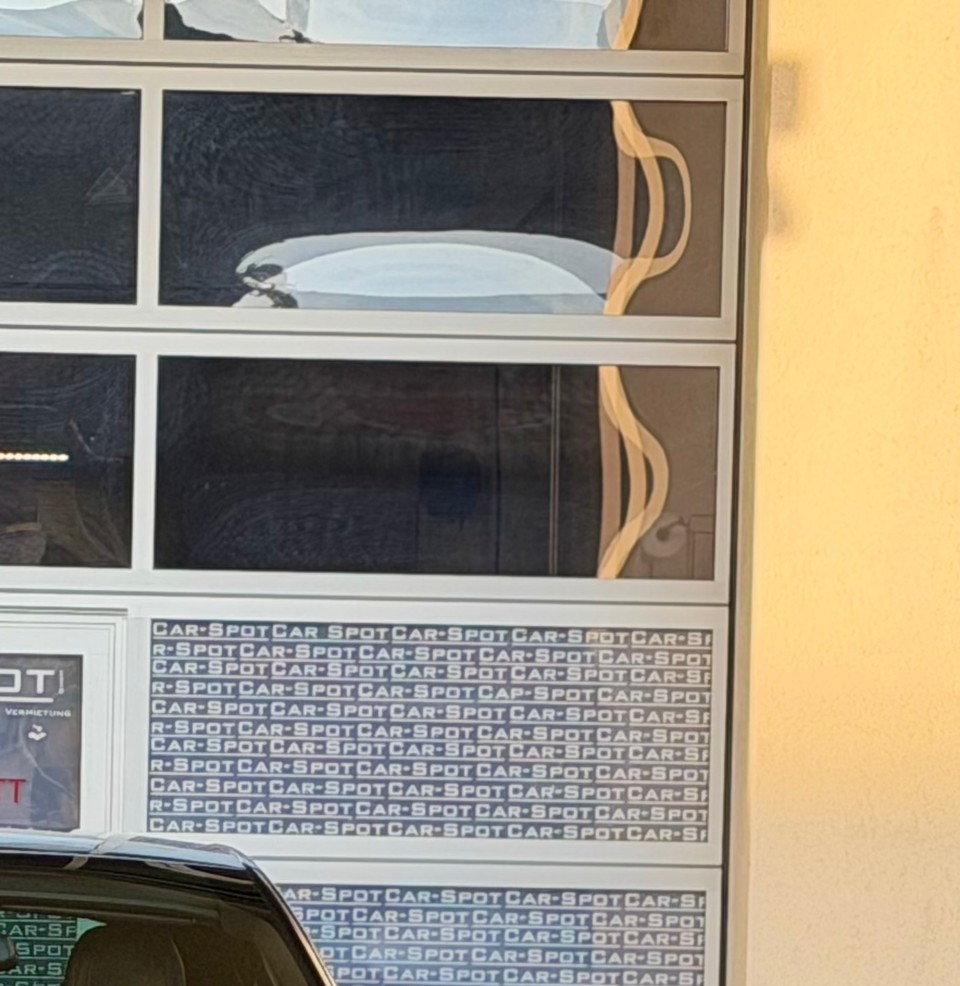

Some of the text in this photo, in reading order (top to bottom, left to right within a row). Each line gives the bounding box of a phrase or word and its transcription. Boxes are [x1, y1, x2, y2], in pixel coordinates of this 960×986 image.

[152, 622, 269, 638] CAR-SPOT
[391, 627, 508, 643] CAR-SPOT
[511, 629, 628, 645] CAR-SPOT
[239, 644, 356, 660] CAR-SPOT
[358, 646, 475, 662] CAR-SPOT
[478, 648, 595, 664] CAR-SPOT
[151, 660, 627, 683] CAR-SPOT CAR-SPOT CAR-SPOT CAR-SPOT
[238, 682, 355, 698] CAR-SPOT
[357, 684, 474, 700] CAR-SPOT
[5, 707, 71, 717] VERMIETUNG
[151, 700, 626, 723] CAR-SPOT CAR-SPOT CAR-SPOT CAR-SPOT
[237, 722, 354, 738] CAR-SPOT
[356, 724, 473, 740] CAR-SPOT
[476, 726, 593, 742] CAR-SPOT
[150, 738, 625, 761] CAR-SPOT CAR-SPOT CAR-SPOT CAR-SPOT
[236, 760, 353, 776] CAR-SPOT
[355, 762, 472, 778] CAR-SPOT
[475, 764, 592, 780] CAR-SPOT
[149, 778, 624, 801] CAR-SPOT CAR-SPOT CAR-SPOT CAR-SPOT
[235, 800, 352, 816] CAR-SPOT
[355, 802, 472, 818] CAR-SPOT
[474, 804, 591, 820] CAR-SPOT
[148, 818, 624, 841] CAR-SPOT CAR-SPOT CAR-SPOT CAR-SPOT
[385, 889, 623, 907] CAR-SPOT CAR-SPOT
[352, 908, 470, 924] CAR-SPOT
[472, 910, 590, 926] CAR-SPOT
[384, 927, 622, 945] CAR-SPOT CAR-SPOT
[351, 946, 469, 962] CAR-SPOT
[471, 948, 589, 964] CAR-SPOT
[383, 967, 621, 985] CAR-SPOT CAR-SPOT
